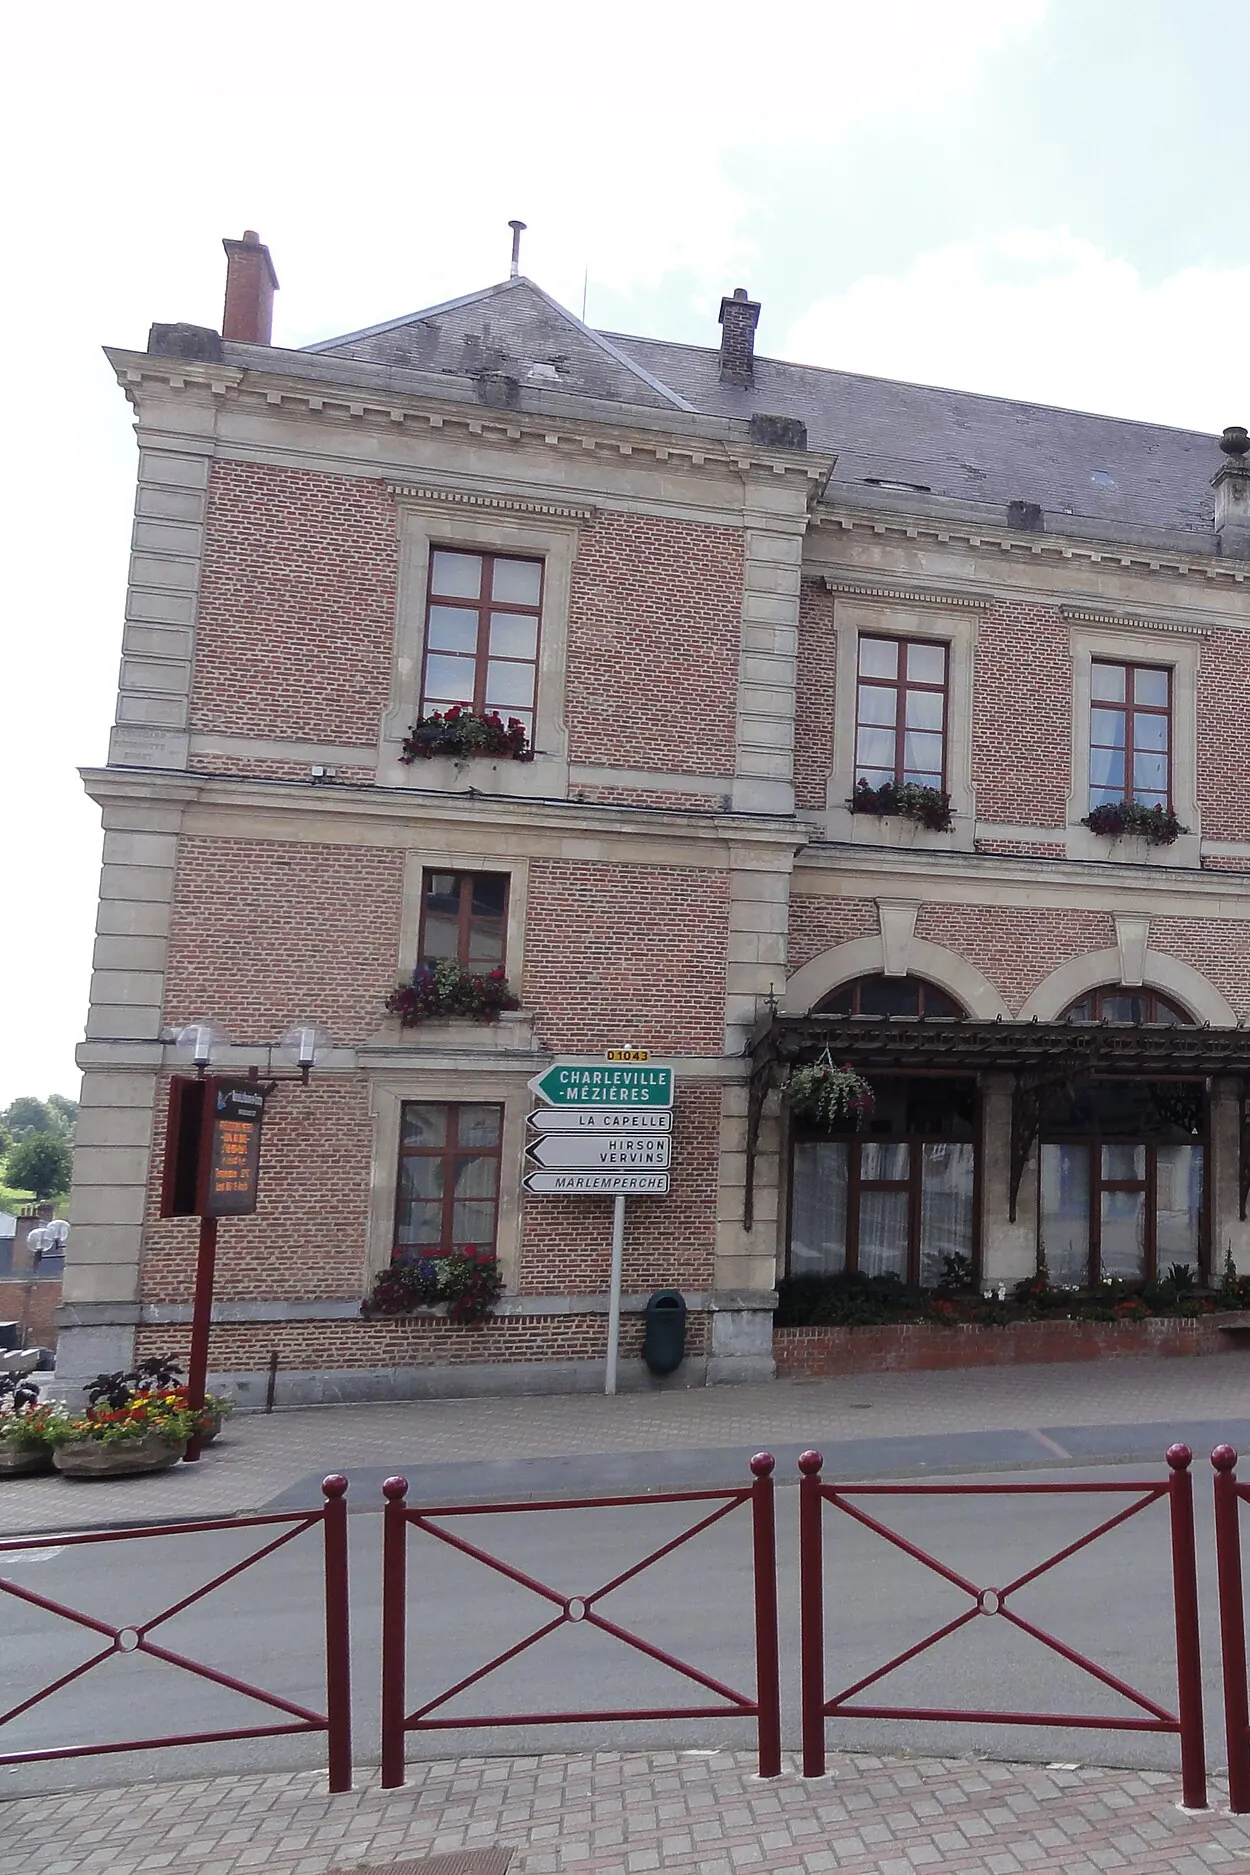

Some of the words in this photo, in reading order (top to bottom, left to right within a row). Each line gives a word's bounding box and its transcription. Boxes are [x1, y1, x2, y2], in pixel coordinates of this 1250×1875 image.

[617, 1051, 648, 1061] 1043
[560, 1071, 667, 1085] CHARLEVILLE
[559, 1085, 650, 1100] -MÉZIÈRES
[579, 1116, 596, 1126] LA
[603, 1116, 666, 1126] CAPELLE
[609, 1140, 665, 1150] HIRSON
[600, 1153, 664, 1163] VERVINS
[554, 1177, 665, 1188] MARLEMPERCHE
